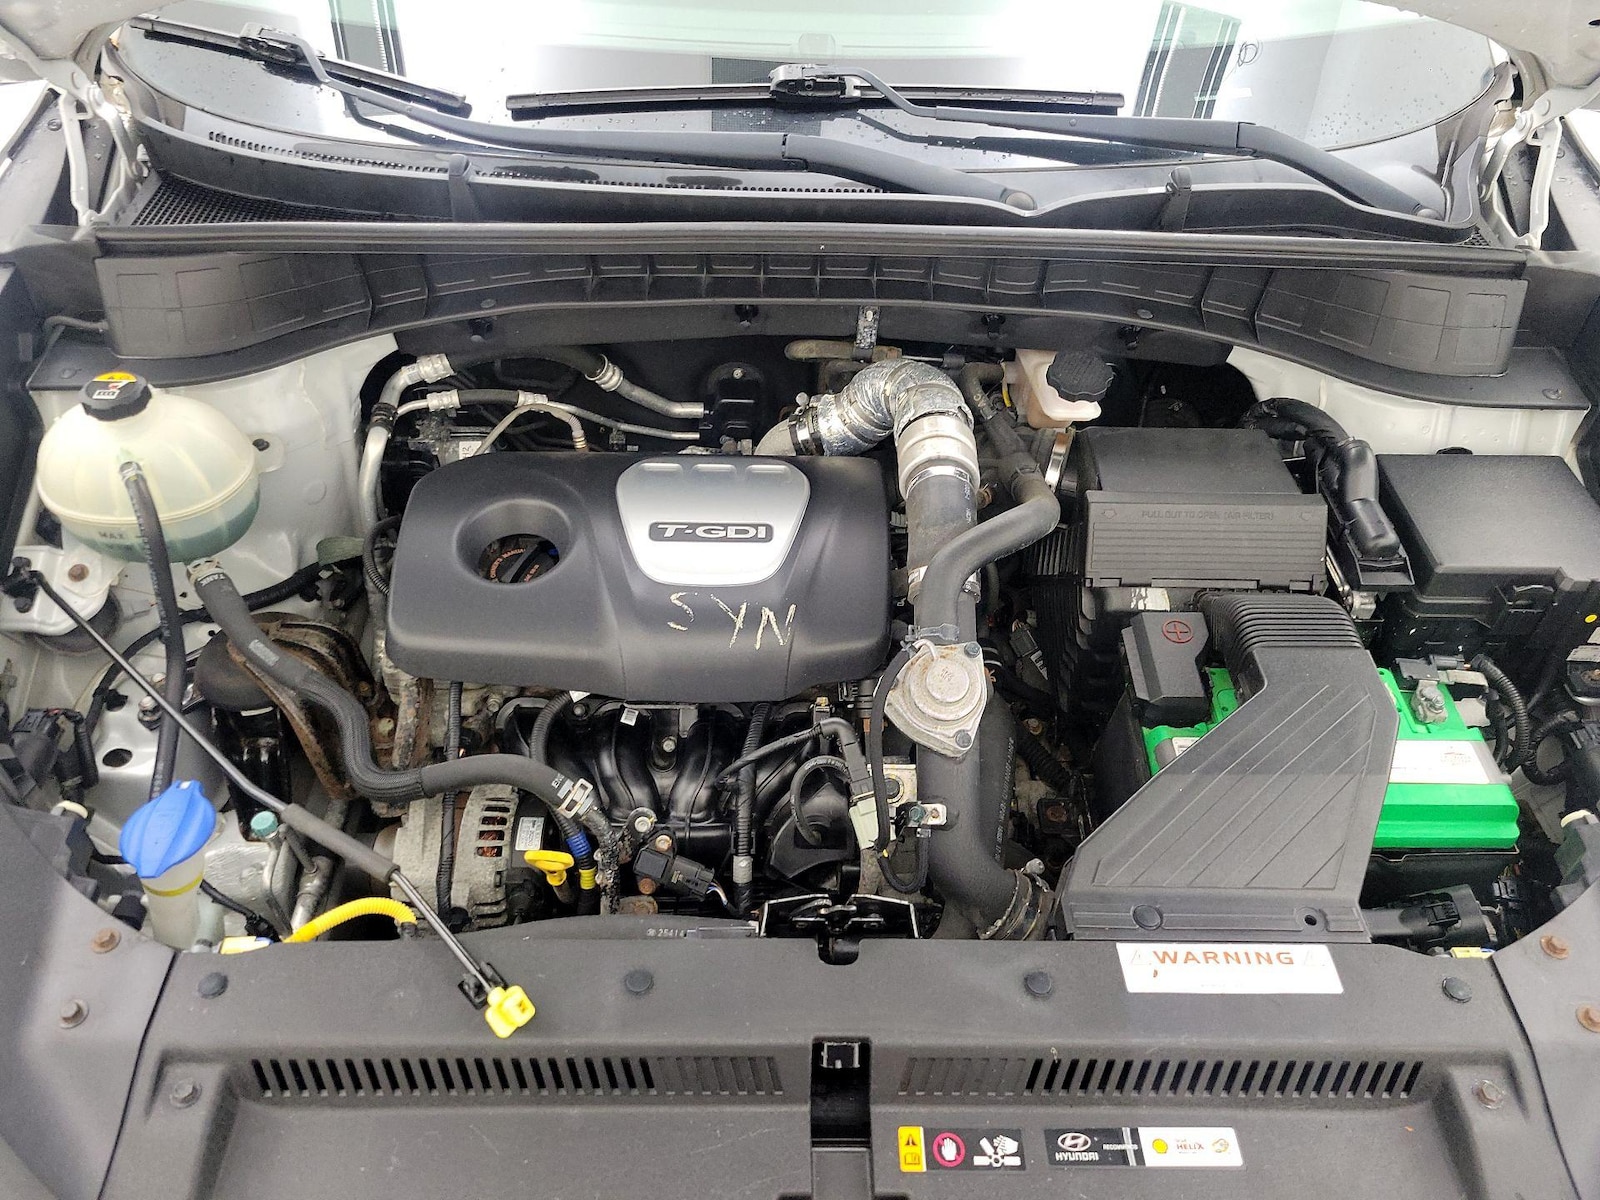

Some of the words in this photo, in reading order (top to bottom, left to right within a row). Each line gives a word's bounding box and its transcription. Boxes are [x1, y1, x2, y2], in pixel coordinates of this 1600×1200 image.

[1142, 510, 1162, 518] PULL
[1165, 510, 1182, 518] OUT
[1184, 510, 1196, 519] TO
[657, 524, 767, 539] T-GDI
[667, 591, 797, 650] SYN
[1152, 950, 1295, 965] WARNING
[1055, 1152, 1100, 1161] HYUNDAI
